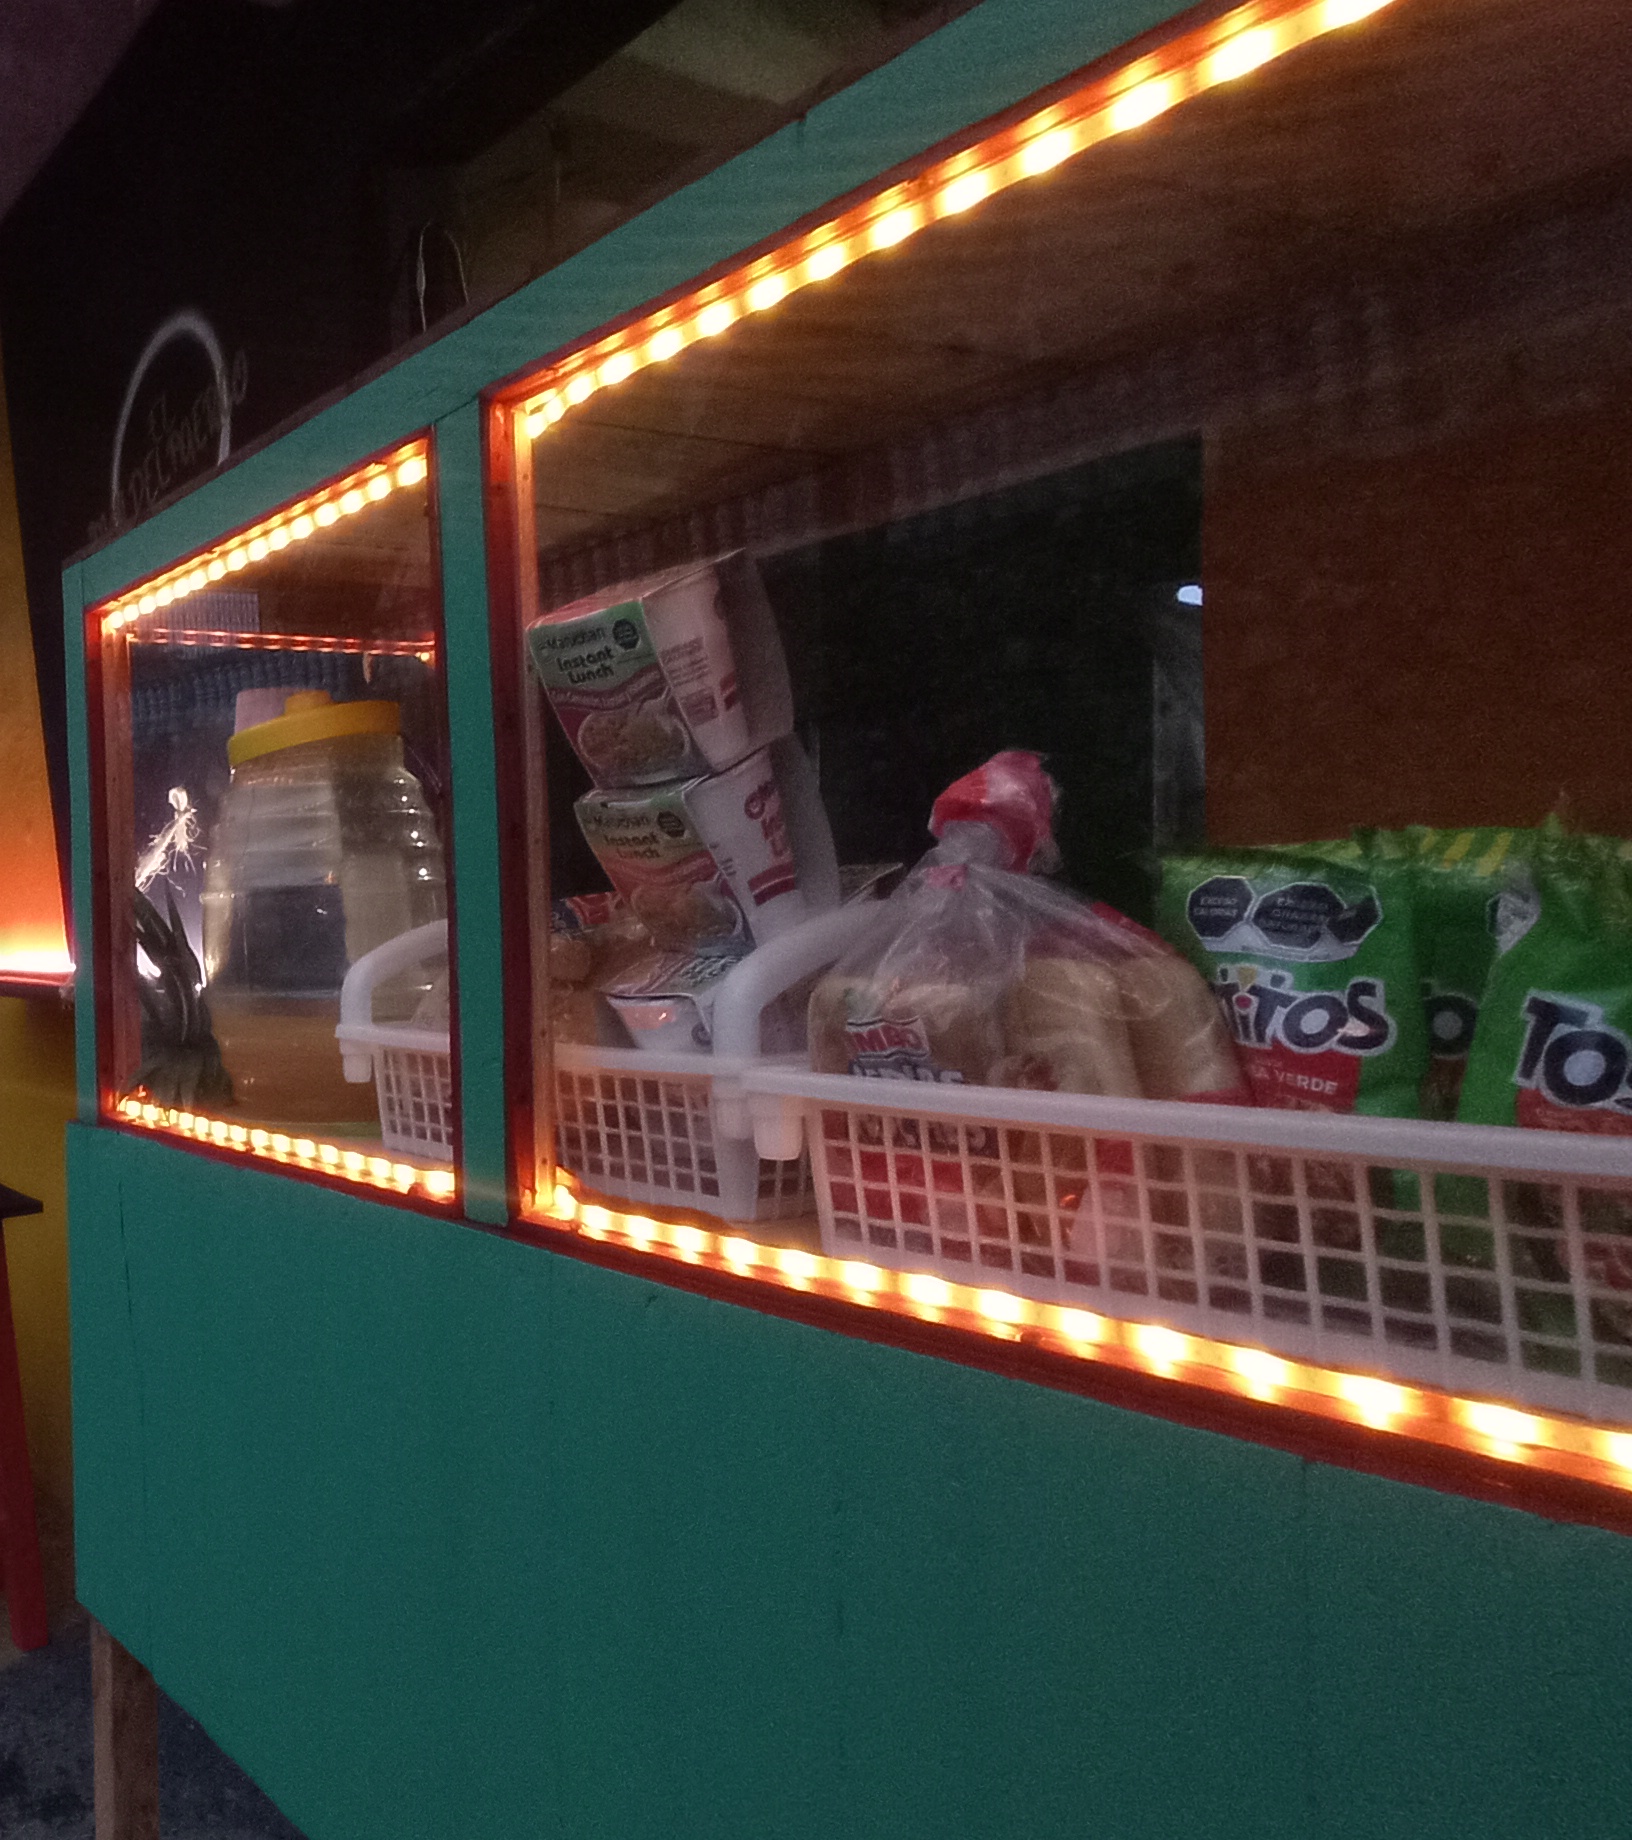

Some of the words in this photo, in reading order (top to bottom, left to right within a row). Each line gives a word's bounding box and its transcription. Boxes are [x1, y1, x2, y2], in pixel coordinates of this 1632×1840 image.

[555, 645, 616, 672] Instant
[566, 663, 615, 684] Lunch
[1274, 1068, 1339, 1095] VERDE
